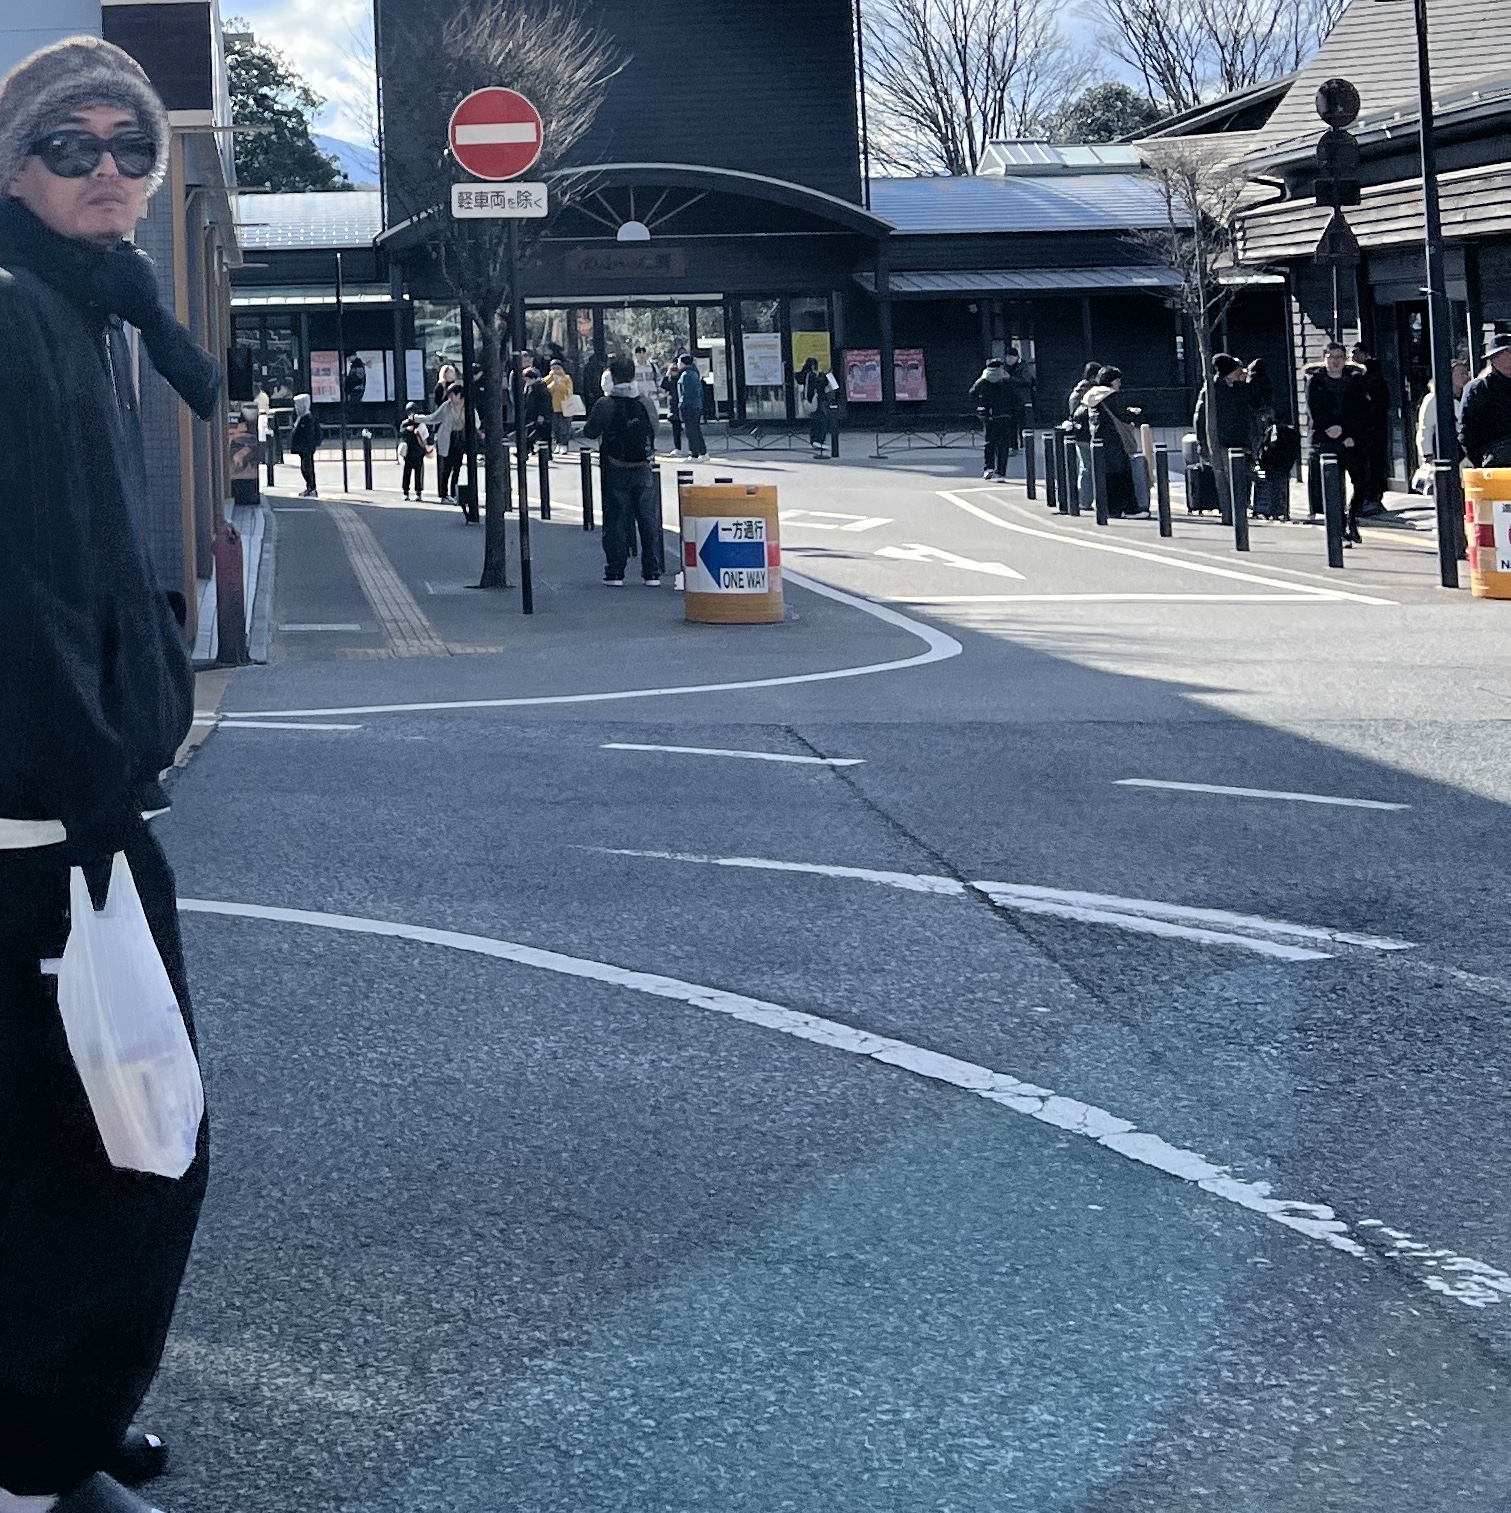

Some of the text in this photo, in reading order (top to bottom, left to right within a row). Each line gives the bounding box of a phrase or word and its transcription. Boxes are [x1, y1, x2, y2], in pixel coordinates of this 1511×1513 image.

[457, 190, 543, 210] 軽車両を除く
[721, 520, 764, 540] 一方通行
[723, 571, 766, 589] ONE WAY
